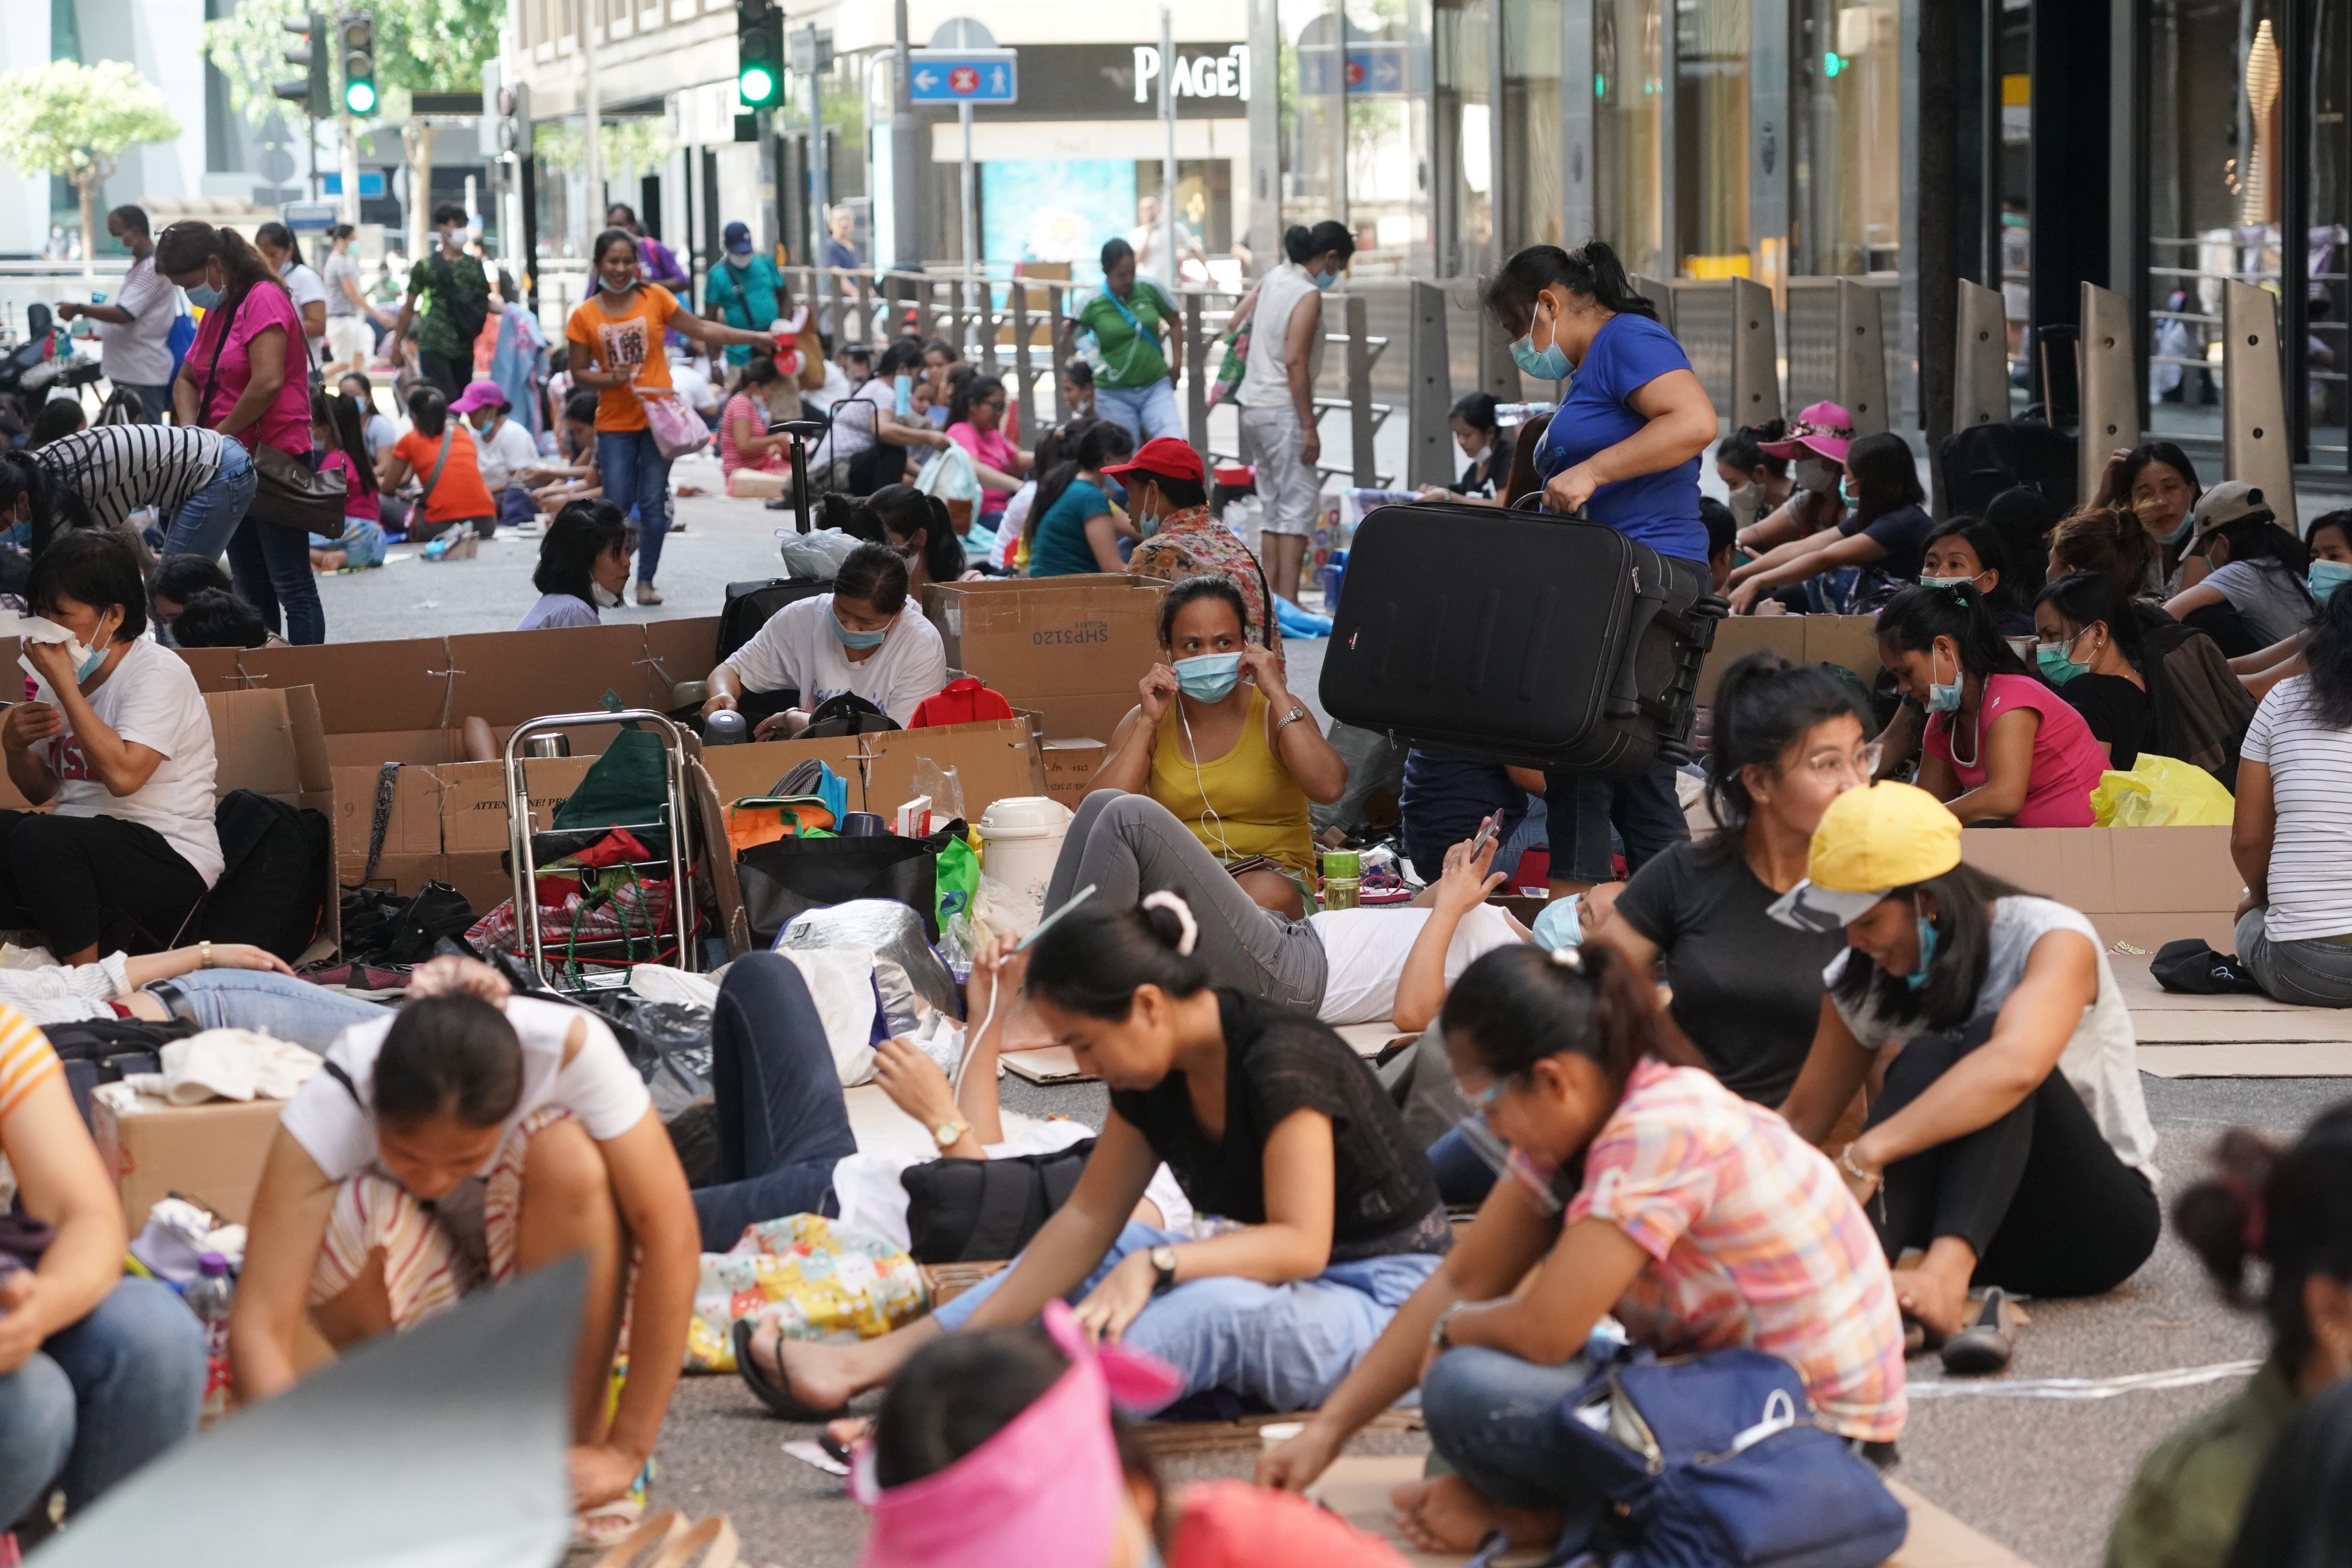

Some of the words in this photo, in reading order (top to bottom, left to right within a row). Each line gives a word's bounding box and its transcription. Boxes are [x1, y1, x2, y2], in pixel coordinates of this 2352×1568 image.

[1133, 45, 1251, 103] PAGET
[1033, 628, 1108, 645] SHP3120
[473, 799, 546, 810] ATTENNE!
